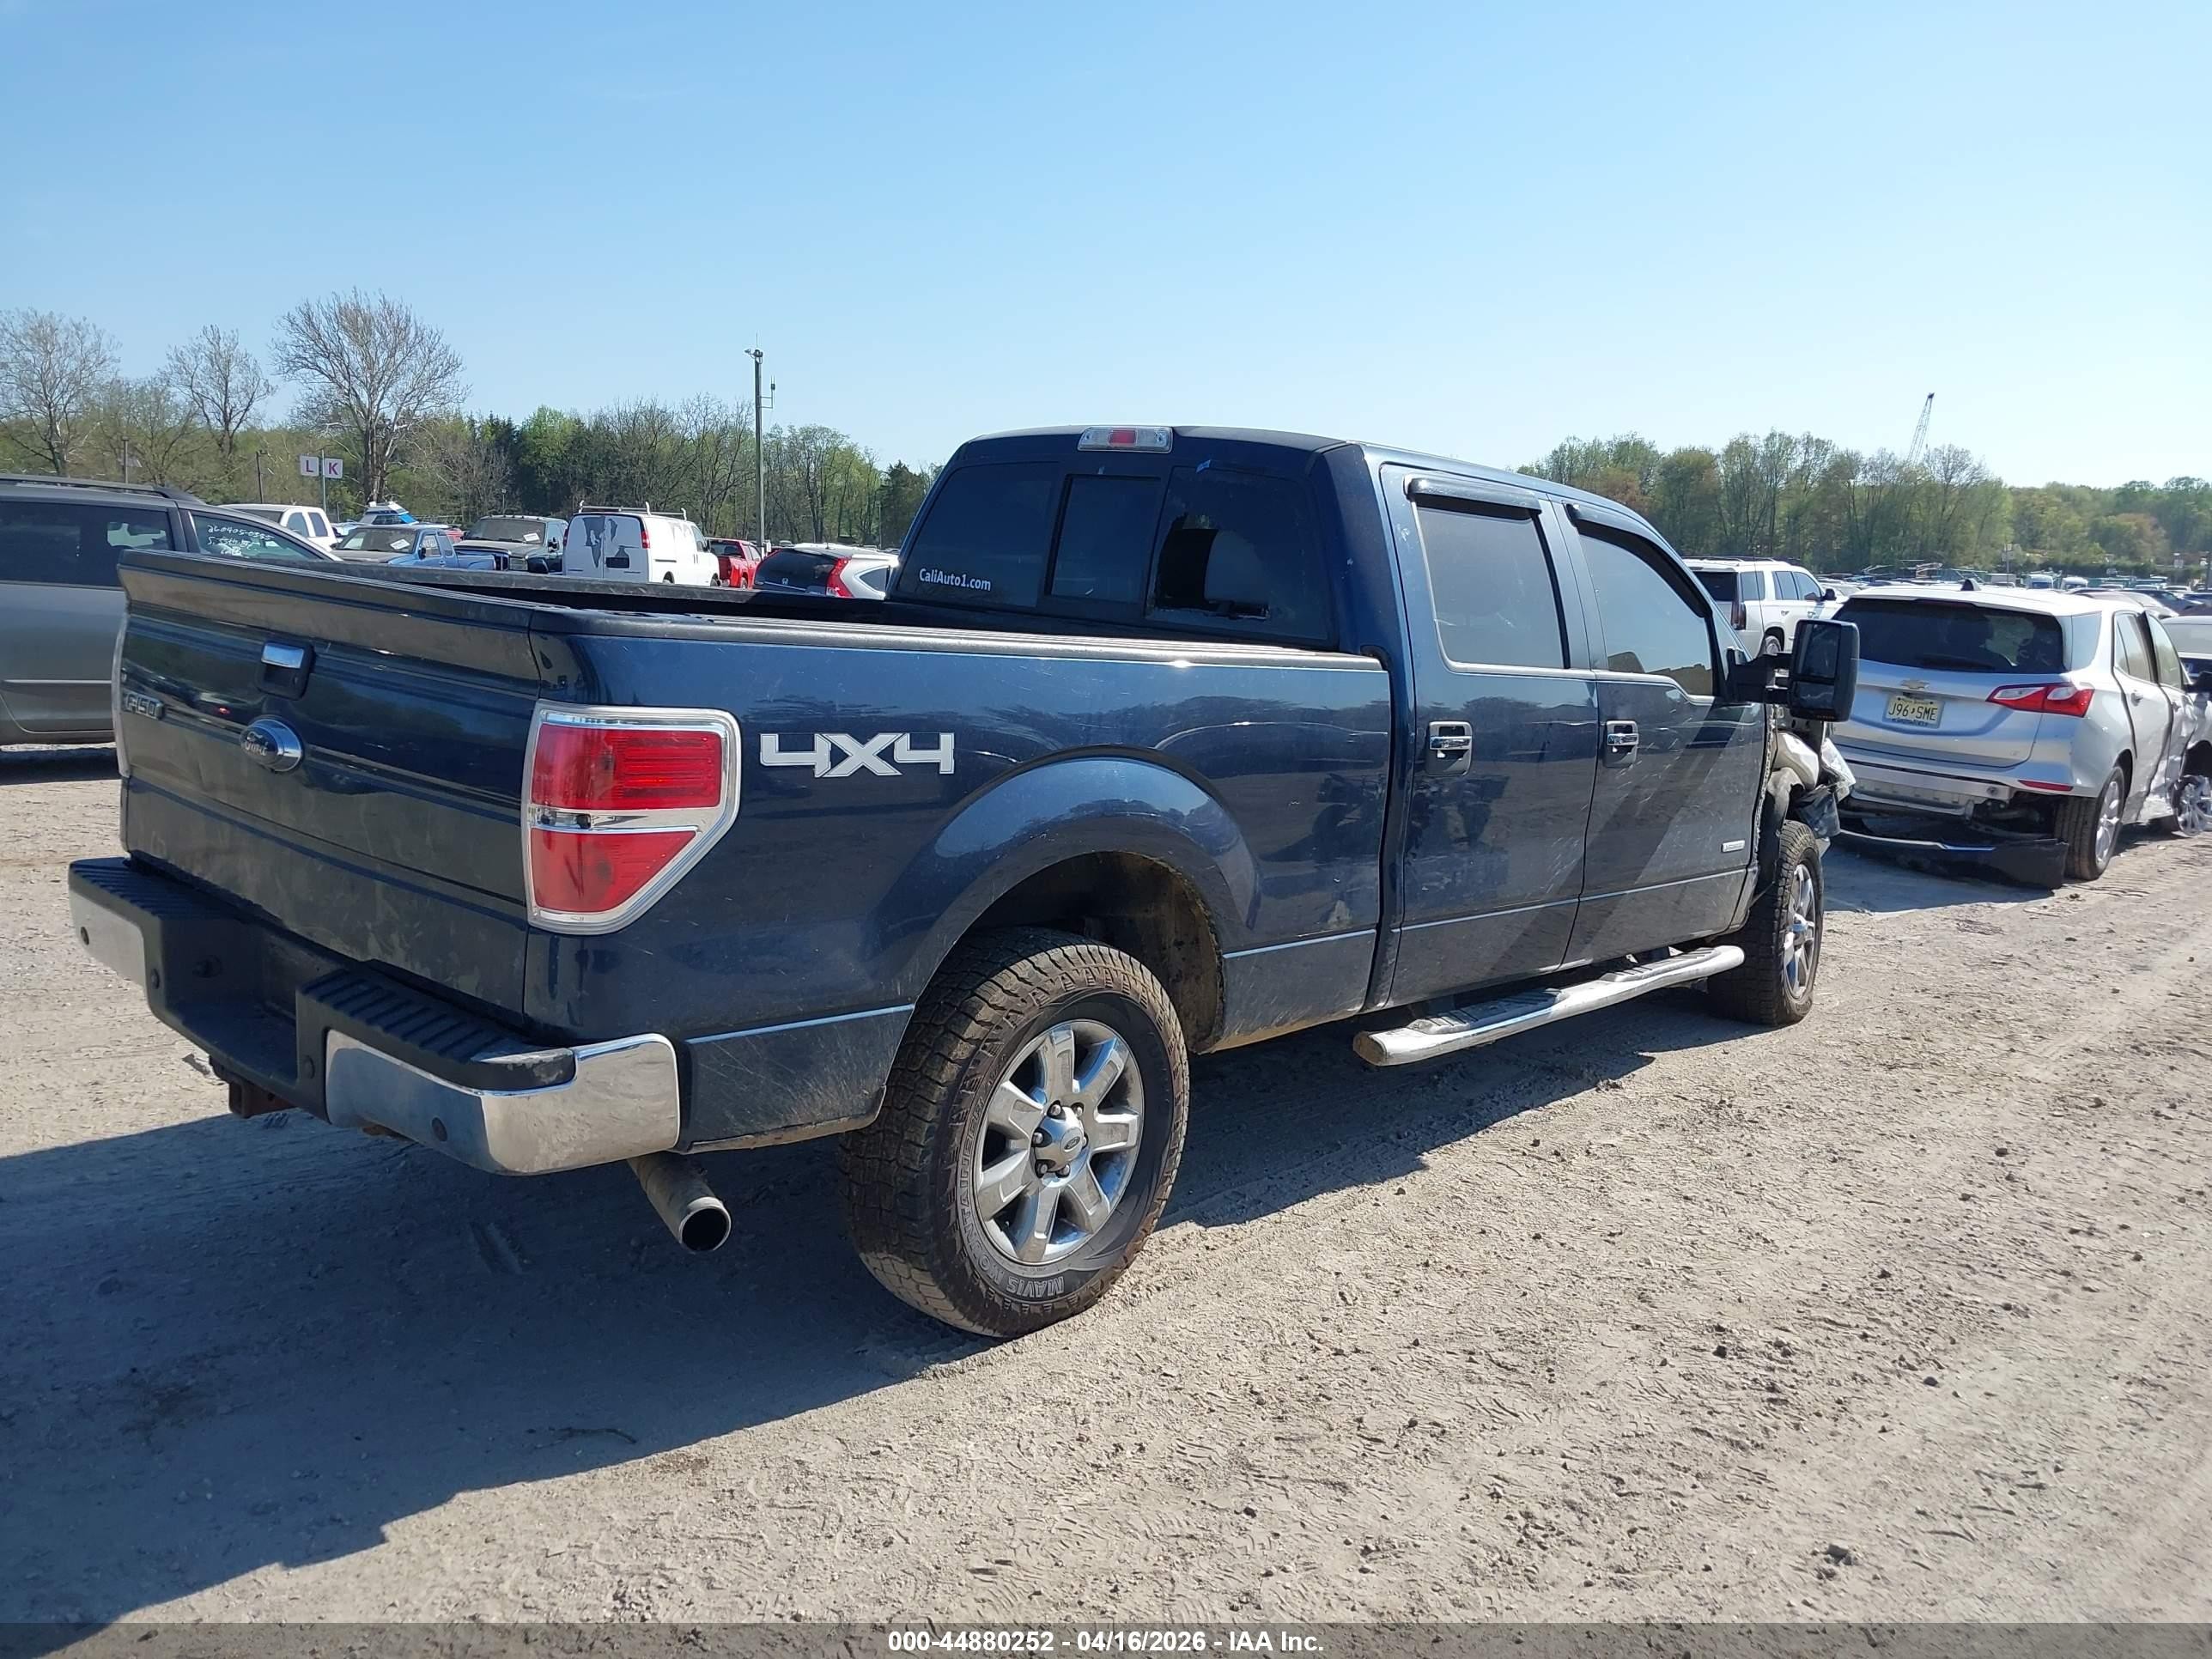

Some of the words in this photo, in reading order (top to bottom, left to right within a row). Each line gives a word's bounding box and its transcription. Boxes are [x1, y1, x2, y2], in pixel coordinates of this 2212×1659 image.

[306, 459, 314, 473] L
[328, 462, 338, 476] K
[919, 568, 992, 592] CaliAuto1.com
[1888, 702, 1910, 717] J96
[1915, 706, 1938, 721] SME
[759, 732, 955, 777] 4X4
[1006, 1275, 1065, 1298] MAVIS
